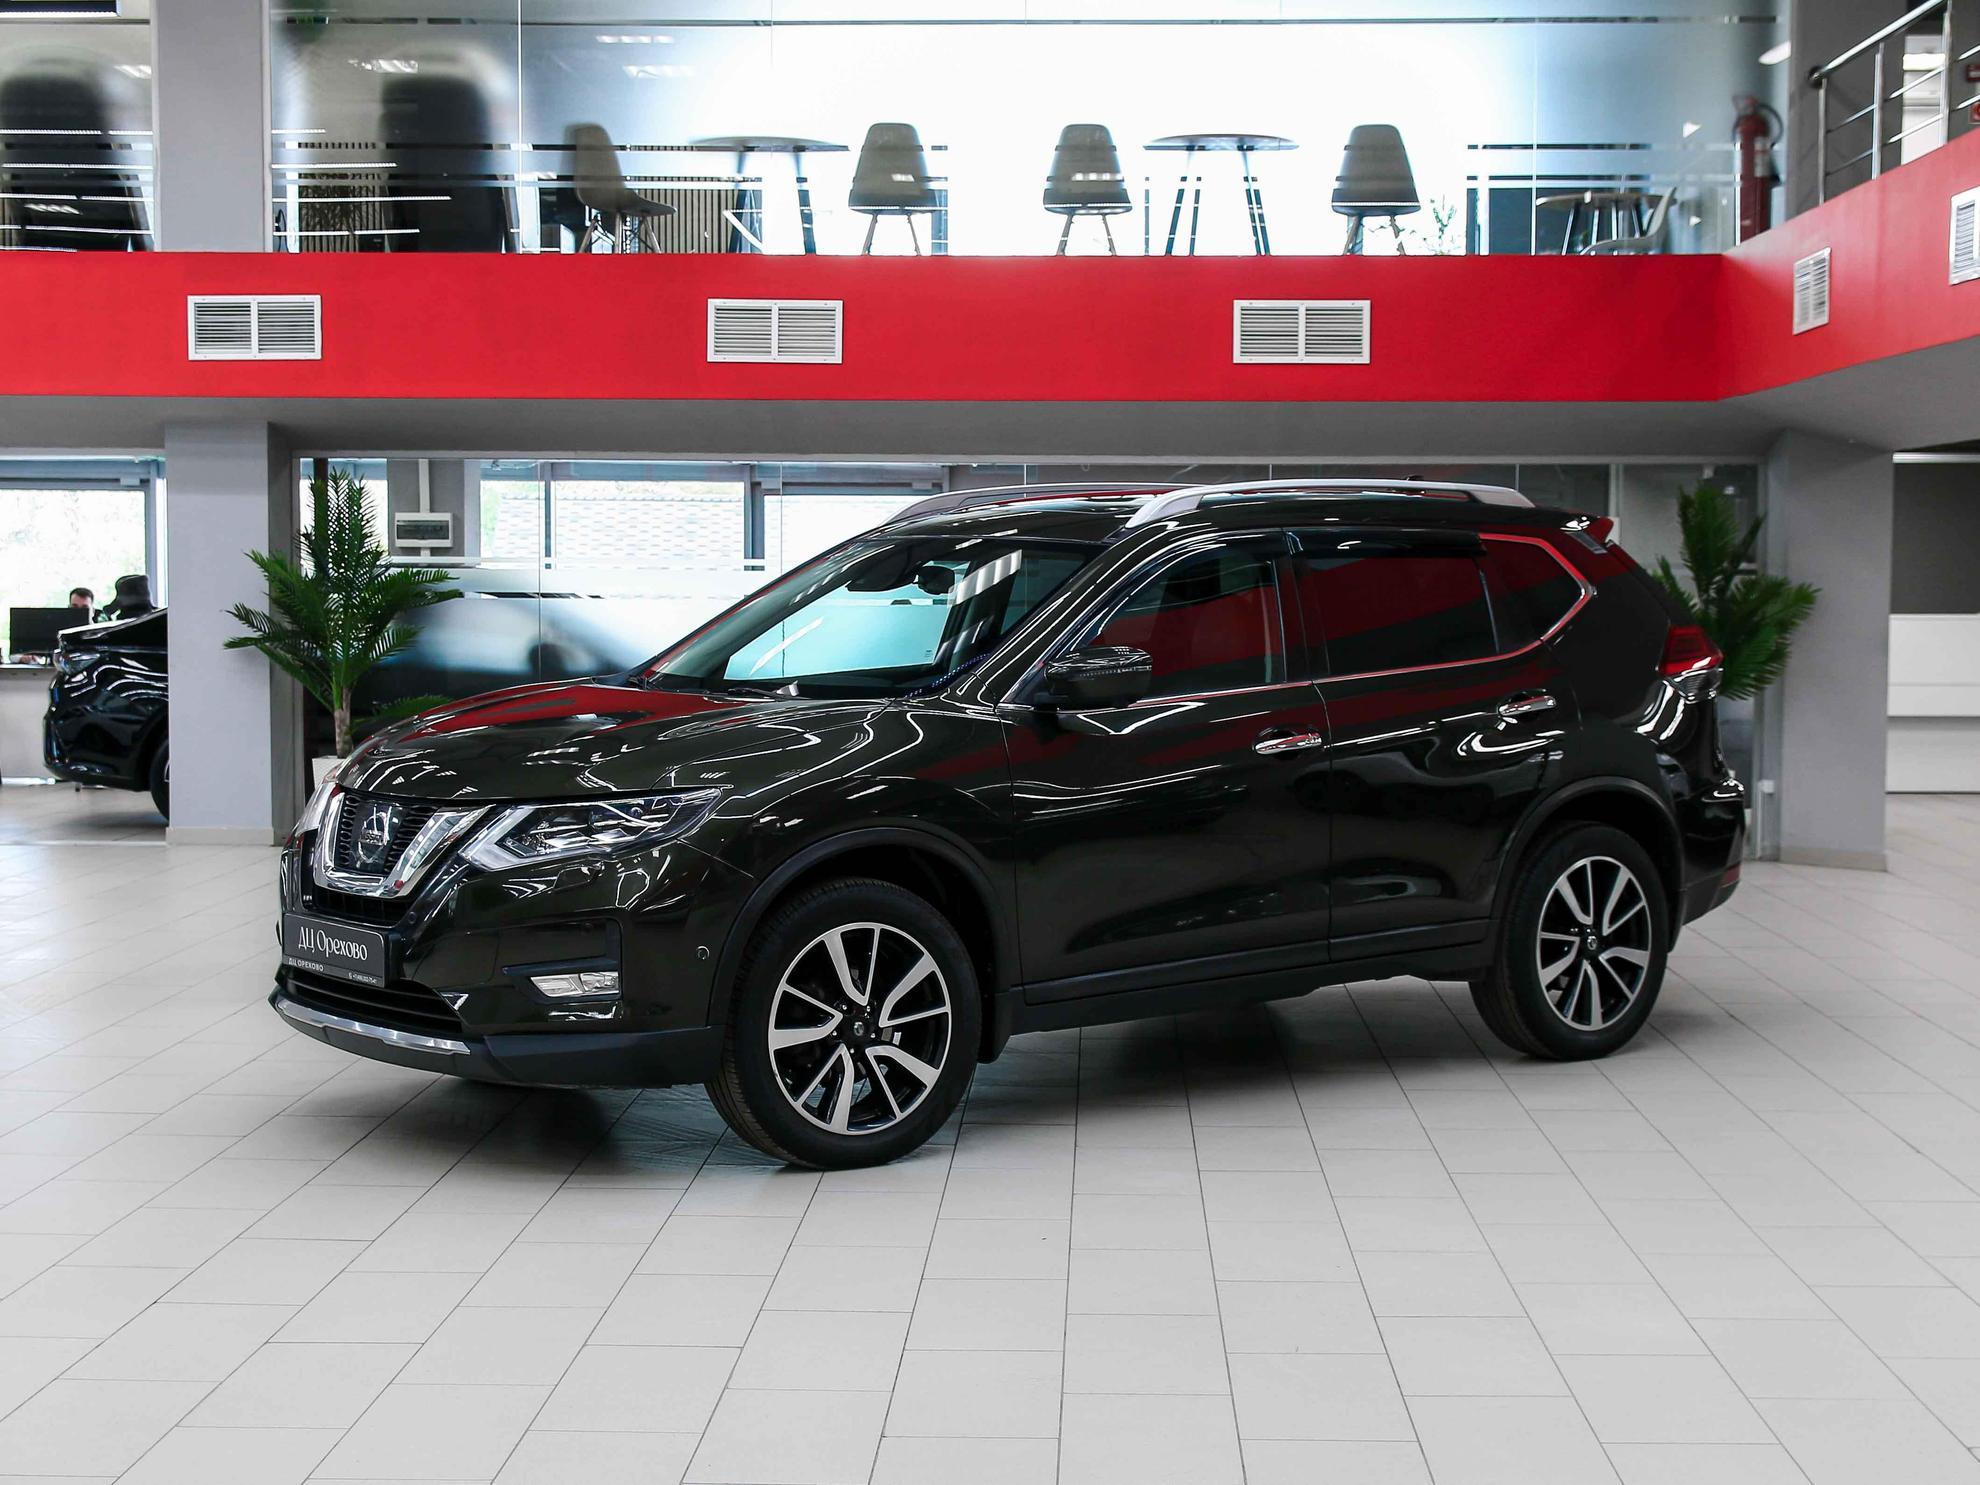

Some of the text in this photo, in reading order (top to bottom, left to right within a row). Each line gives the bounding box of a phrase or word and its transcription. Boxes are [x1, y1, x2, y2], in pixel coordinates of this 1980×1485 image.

[298, 926, 368, 961] ДЦ Орехово
[297, 959, 324, 972] ОРЕХОВО
